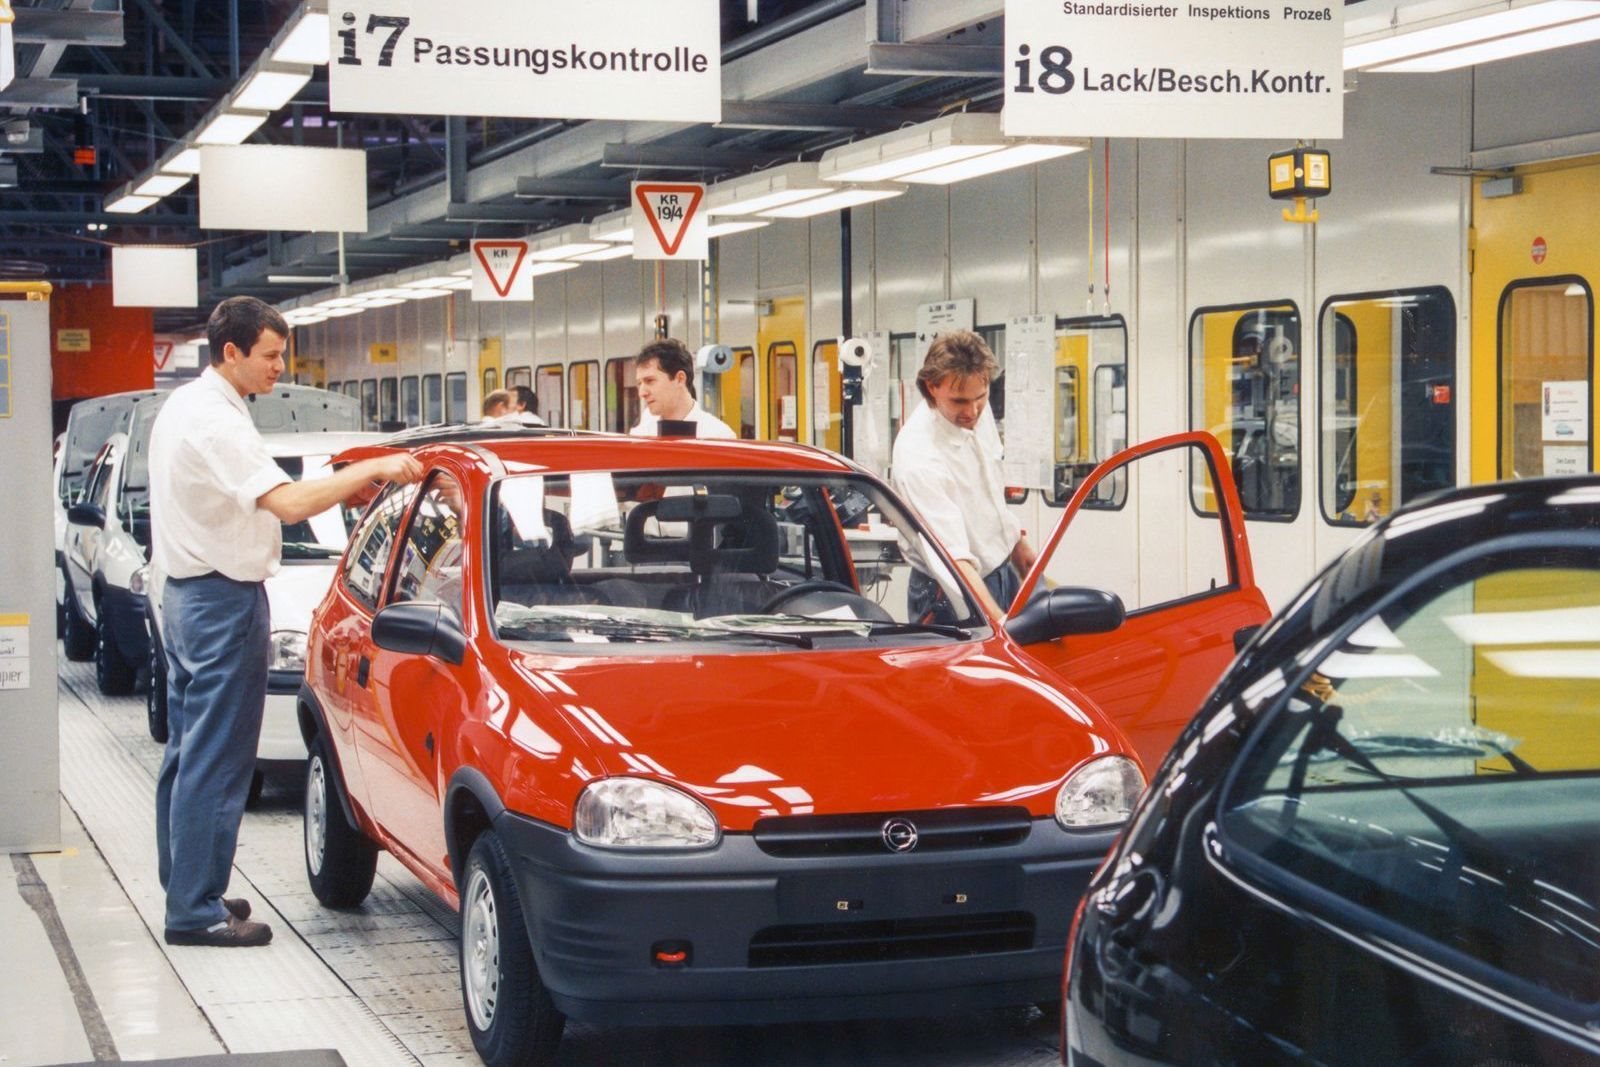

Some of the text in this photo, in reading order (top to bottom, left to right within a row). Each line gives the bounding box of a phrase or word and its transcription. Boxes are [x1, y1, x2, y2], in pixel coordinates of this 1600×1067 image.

[1063, 1, 1332, 21] Standardisierter Inspektions Prozeß
[337, 12, 708, 74] i7 Passungskontrolle
[1014, 44, 1332, 95] i8 Lack/Besch.Kontr.
[660, 194, 678, 205] KR
[657, 205, 683, 222] 19/4
[493, 249, 508, 258] KR
